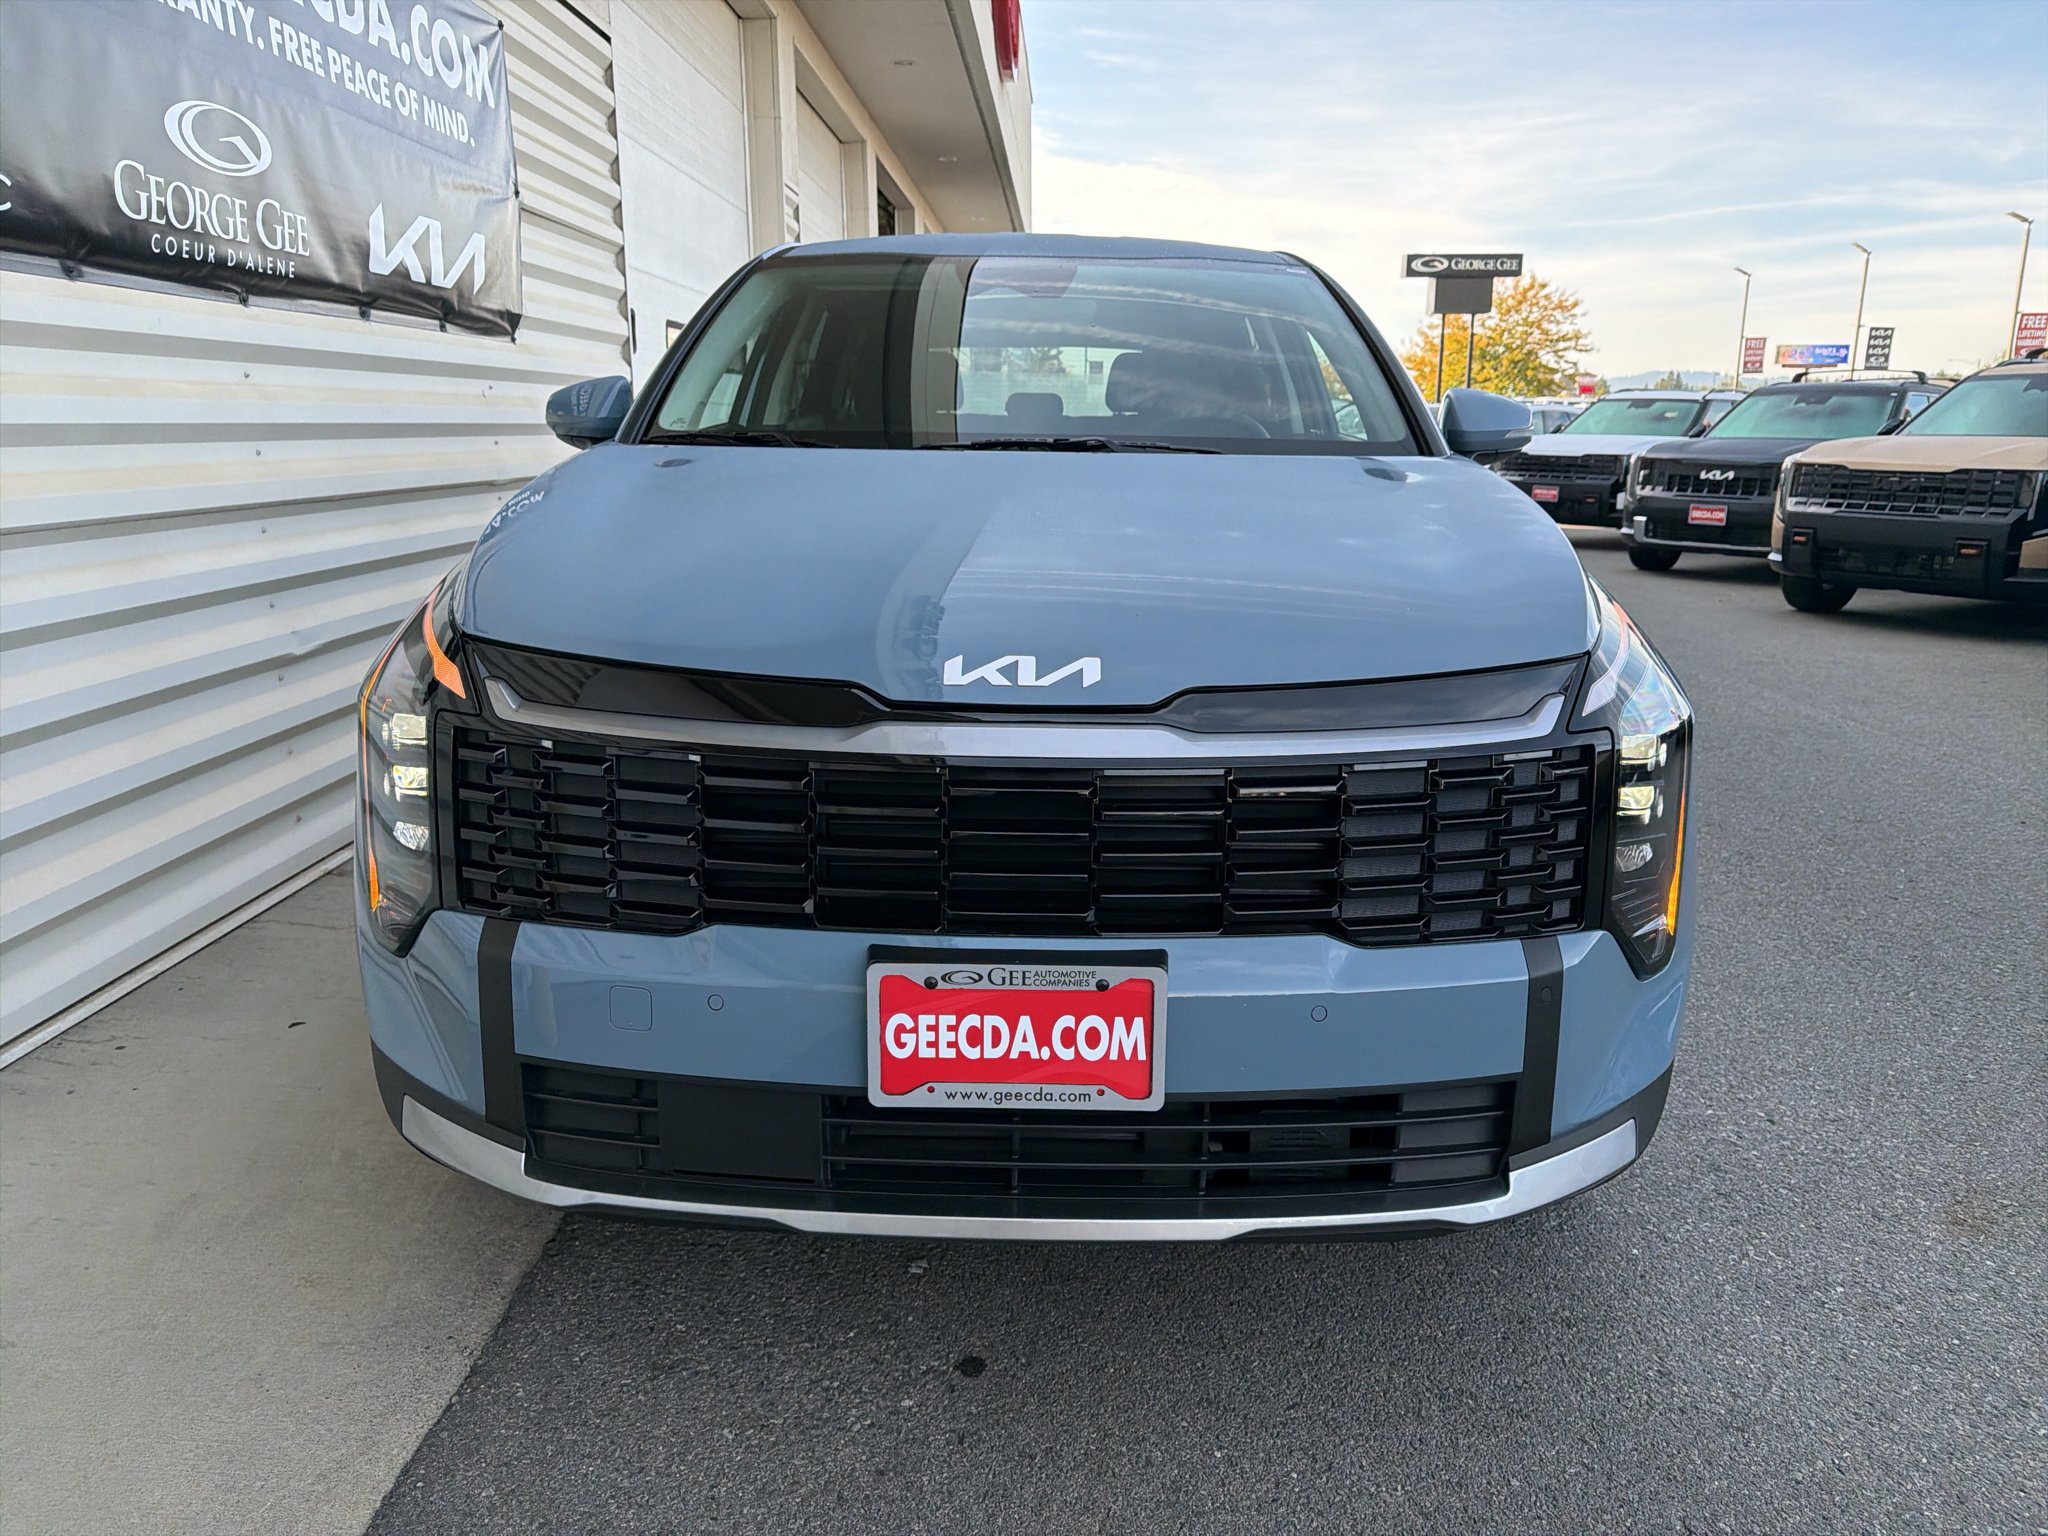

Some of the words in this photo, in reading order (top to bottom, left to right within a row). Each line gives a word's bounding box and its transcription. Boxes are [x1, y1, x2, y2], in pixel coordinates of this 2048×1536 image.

[268, 16, 326, 78] FREE
[327, 46, 392, 109] PEACE
[395, 81, 419, 120] OF
[423, 95, 476, 147] MIND.
[114, 159, 250, 244] GEORGE
[256, 198, 310, 256] GEE
[151, 233, 216, 264] COEUR
[227, 249, 296, 279] D'ALENE
[368, 202, 486, 295] KIA
[1451, 257, 1496, 271] GEORGE
[1496, 257, 1520, 271] GEE
[2021, 315, 2048, 329] FREE
[1700, 469, 1735, 481] KIA
[943, 654, 1101, 688] KIA
[987, 967, 1032, 986] GEE
[1033, 970, 1097, 979] AUTOMOTIVE
[1033, 979, 1090, 987] COMPANIES
[885, 1013, 1147, 1062] GEECDA.COM
[944, 1087, 1092, 1105] www.geecda.com
